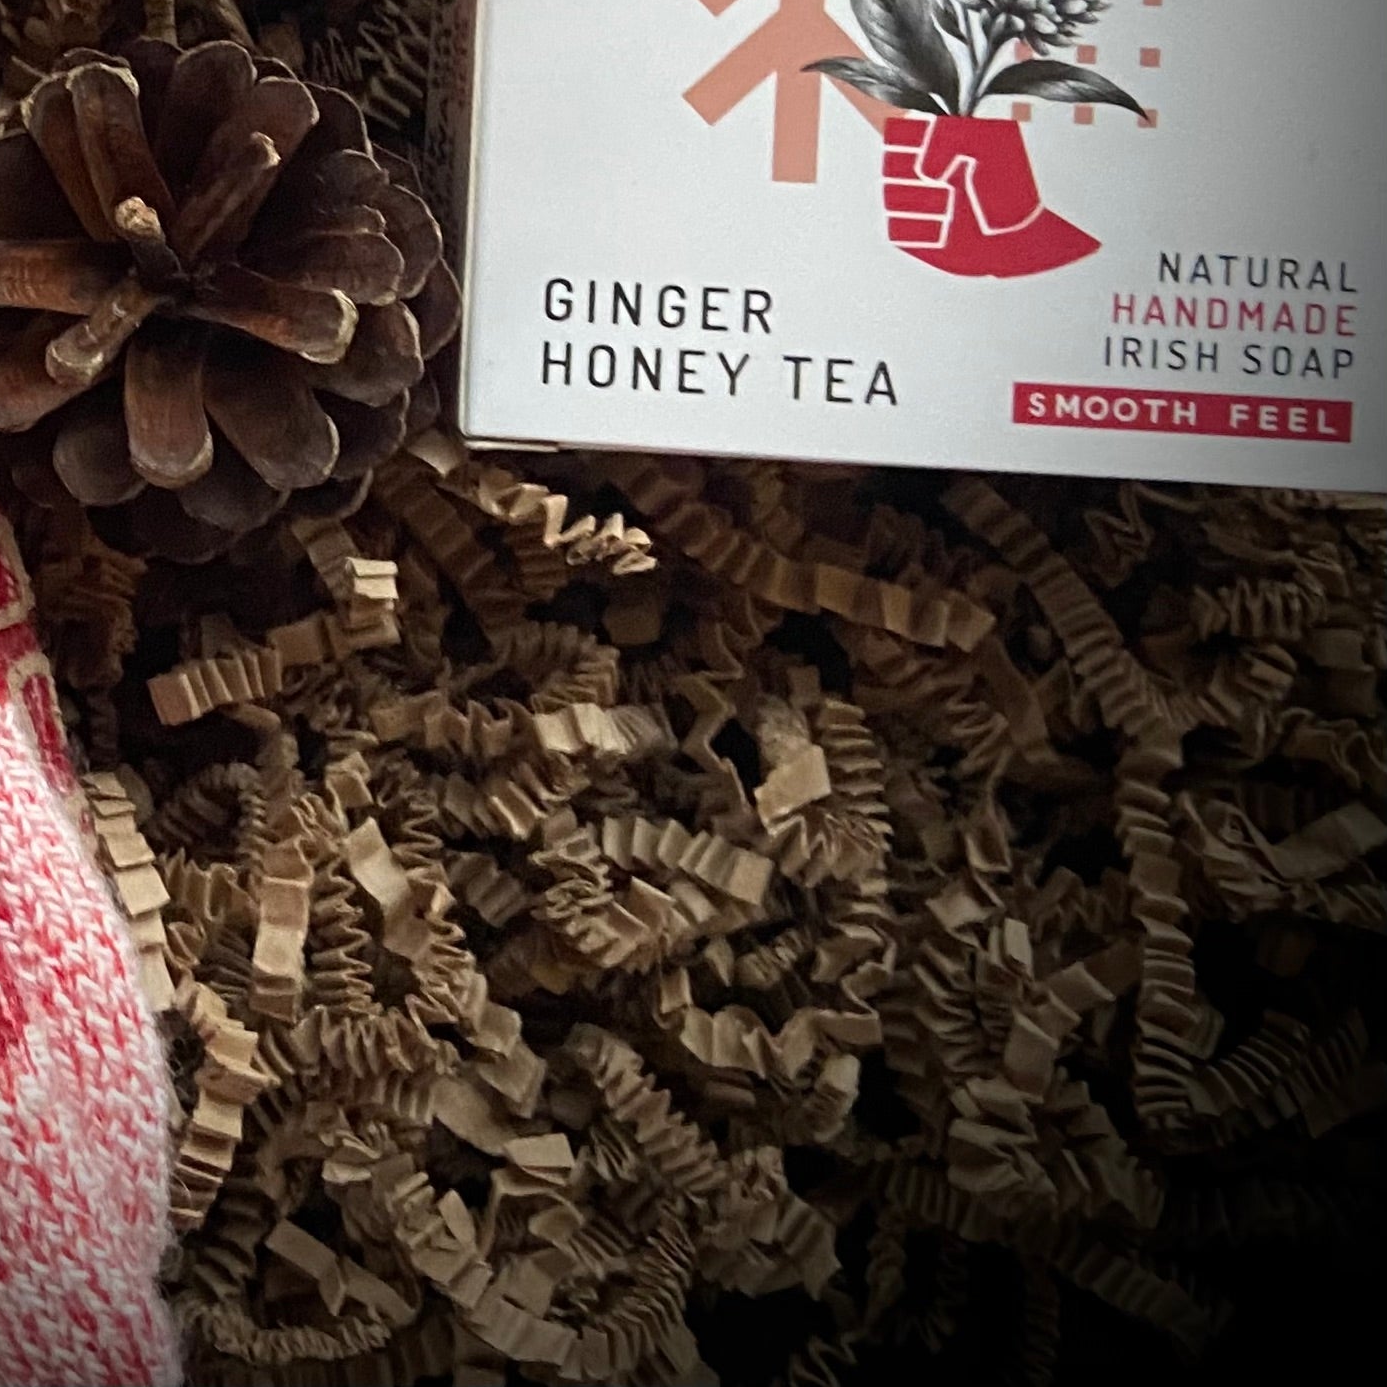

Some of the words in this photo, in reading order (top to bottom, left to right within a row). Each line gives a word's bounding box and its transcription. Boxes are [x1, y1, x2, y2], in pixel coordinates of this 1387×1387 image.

[1158, 252, 1358, 293] NATURAL
[544, 277, 773, 334] GINGER
[1112, 293, 1358, 337] HANDMADE
[541, 341, 750, 397] HONEY
[783, 355, 898, 406] TEA
[1105, 336, 1219, 373] IRISH
[1242, 344, 1354, 379] SOAP
[1027, 392, 1198, 427] SMOOTH
[1229, 404, 1337, 435] FEEL
